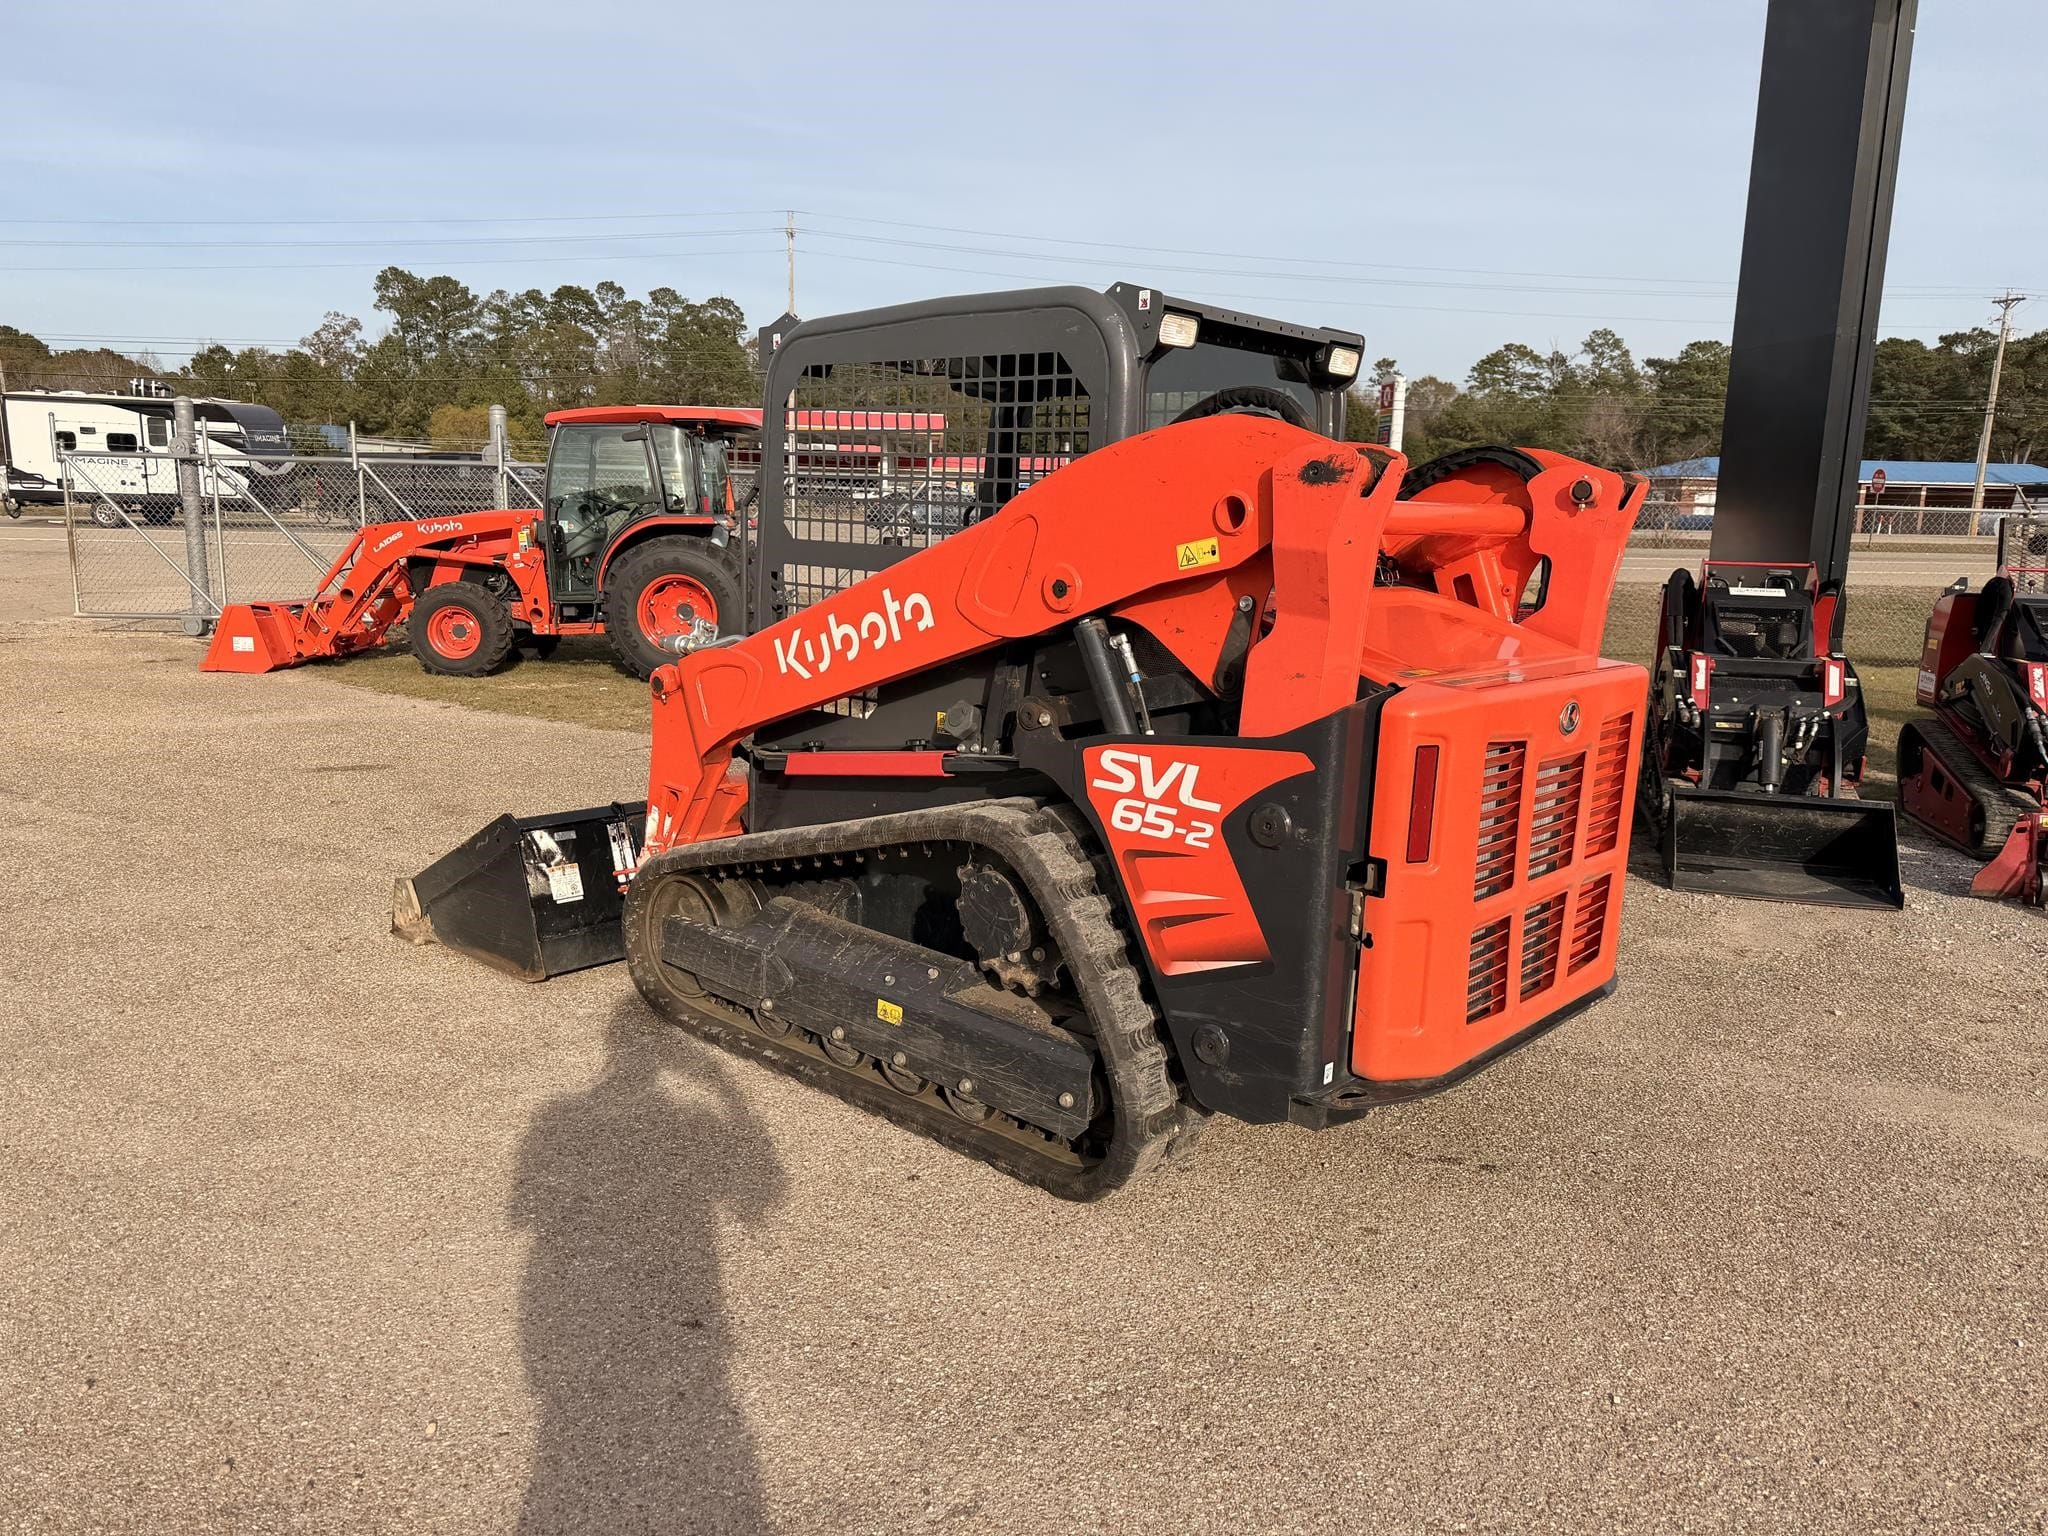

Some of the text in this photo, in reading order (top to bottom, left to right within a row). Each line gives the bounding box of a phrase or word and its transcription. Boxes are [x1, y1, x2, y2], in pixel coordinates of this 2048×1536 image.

[416, 519, 463, 534] Kubota
[773, 587, 936, 680] Kubota
[1092, 749, 1222, 813] SVL
[1111, 798, 1215, 849] 65-2
